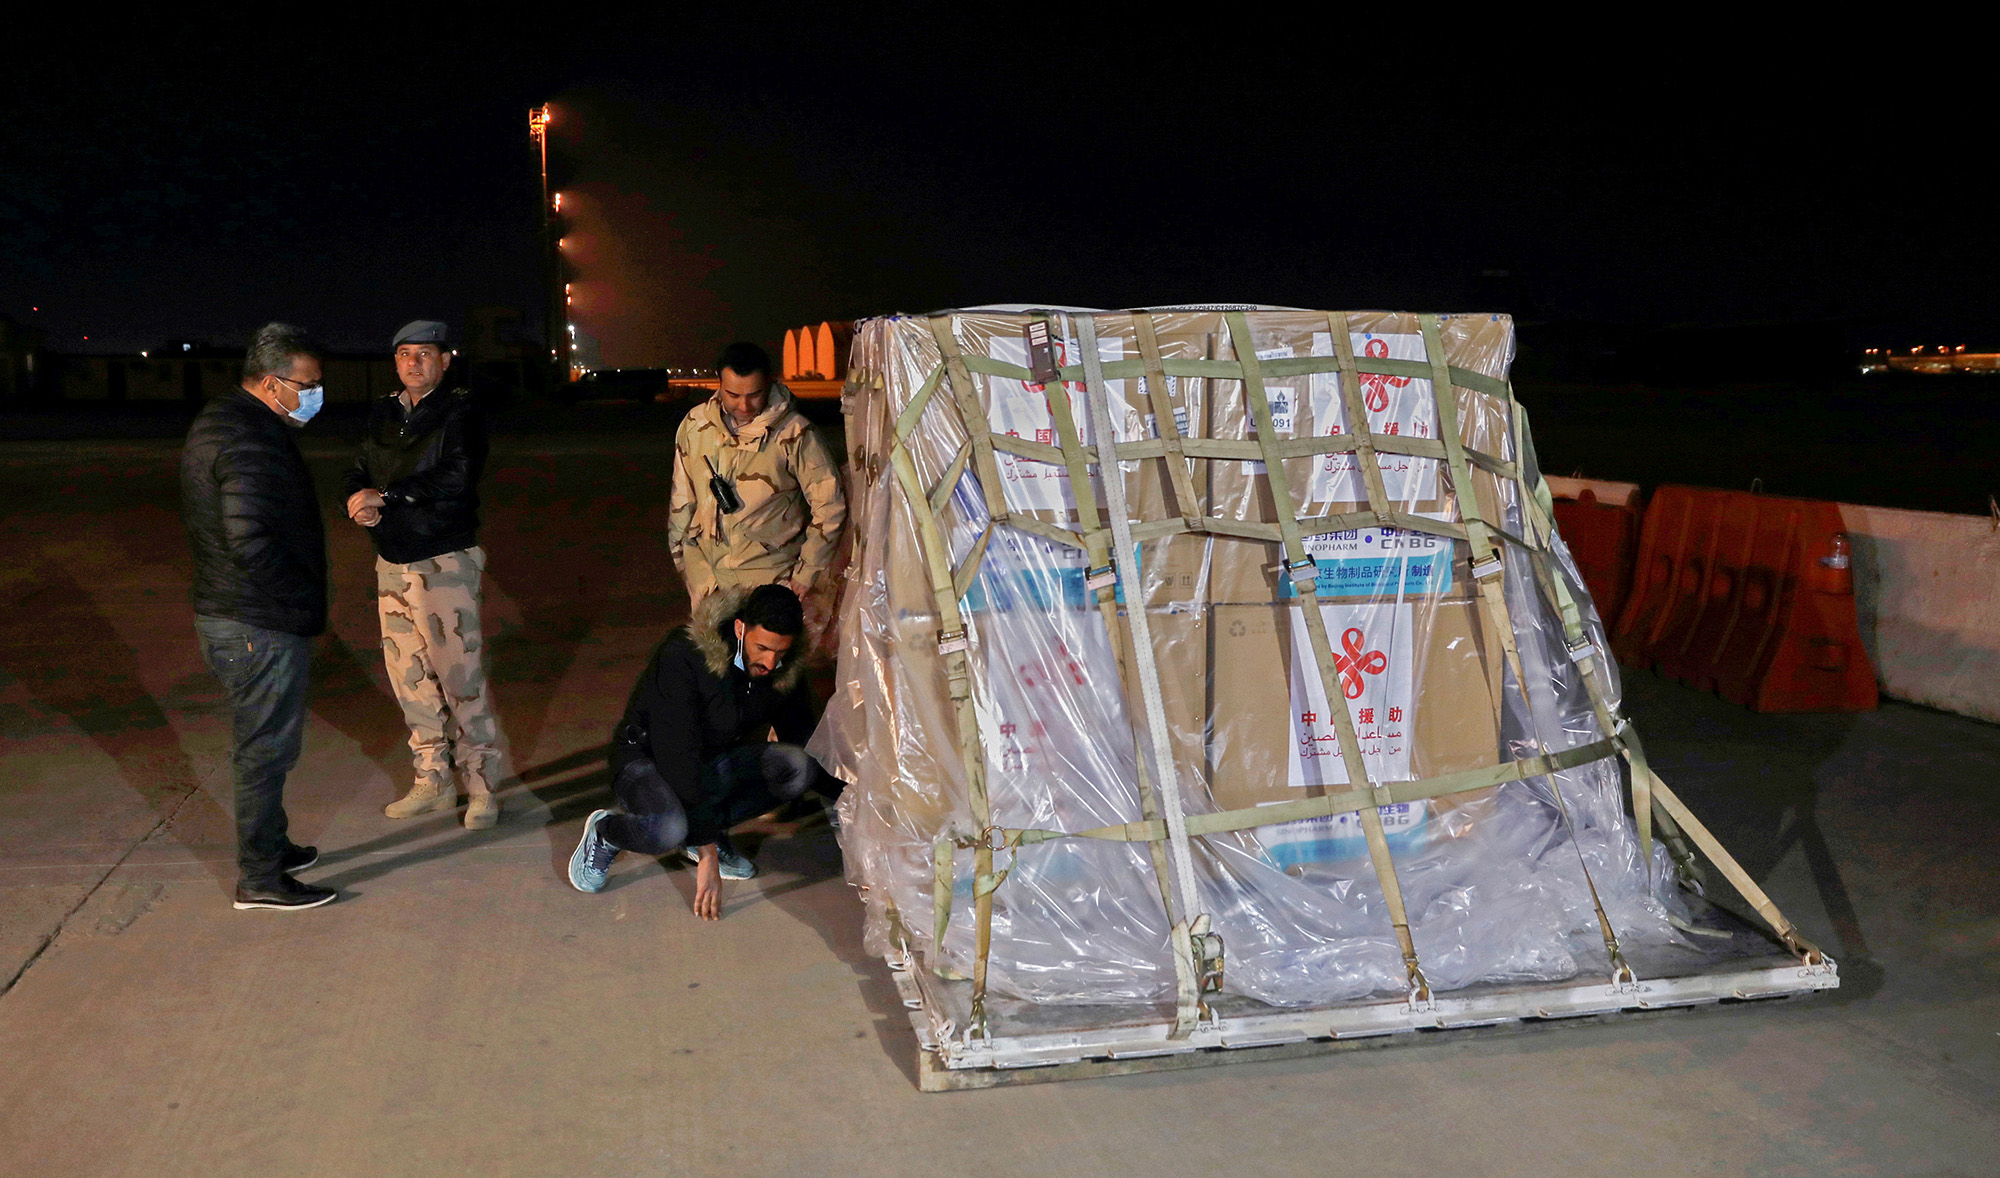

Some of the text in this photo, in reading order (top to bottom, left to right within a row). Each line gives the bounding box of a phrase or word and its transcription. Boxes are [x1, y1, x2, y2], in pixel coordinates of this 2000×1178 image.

[1301, 706, 1402, 727] 中援助
[1300, 747, 1331, 760] مشترك
